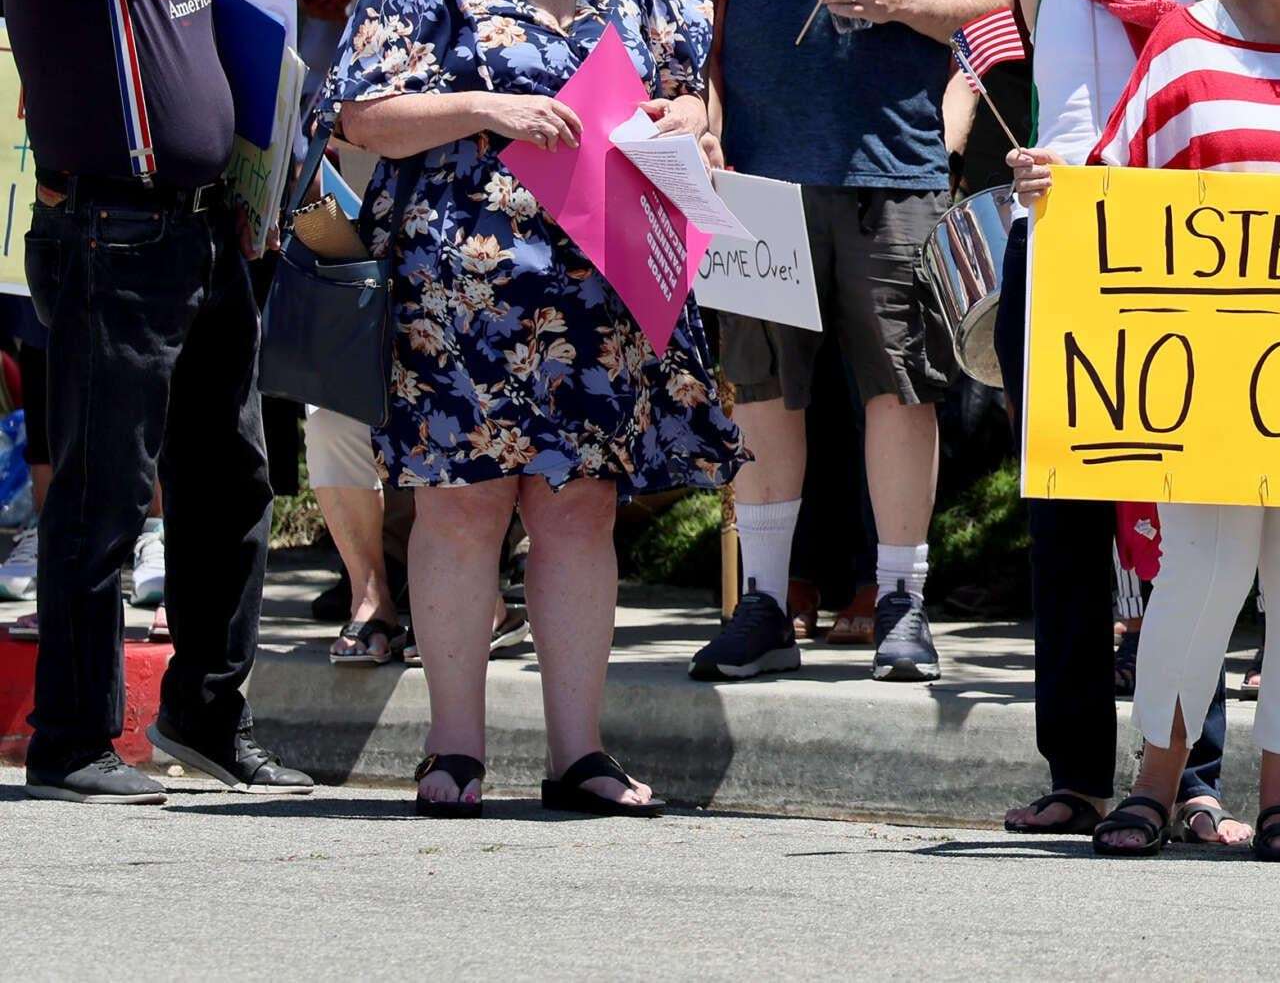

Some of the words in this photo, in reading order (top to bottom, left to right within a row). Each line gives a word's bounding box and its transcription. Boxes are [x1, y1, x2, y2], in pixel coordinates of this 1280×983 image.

[640, 195, 682, 275] PARENTHOOD
[756, 240, 799, 285] Over!
[1064, 328, 1194, 434] NO
